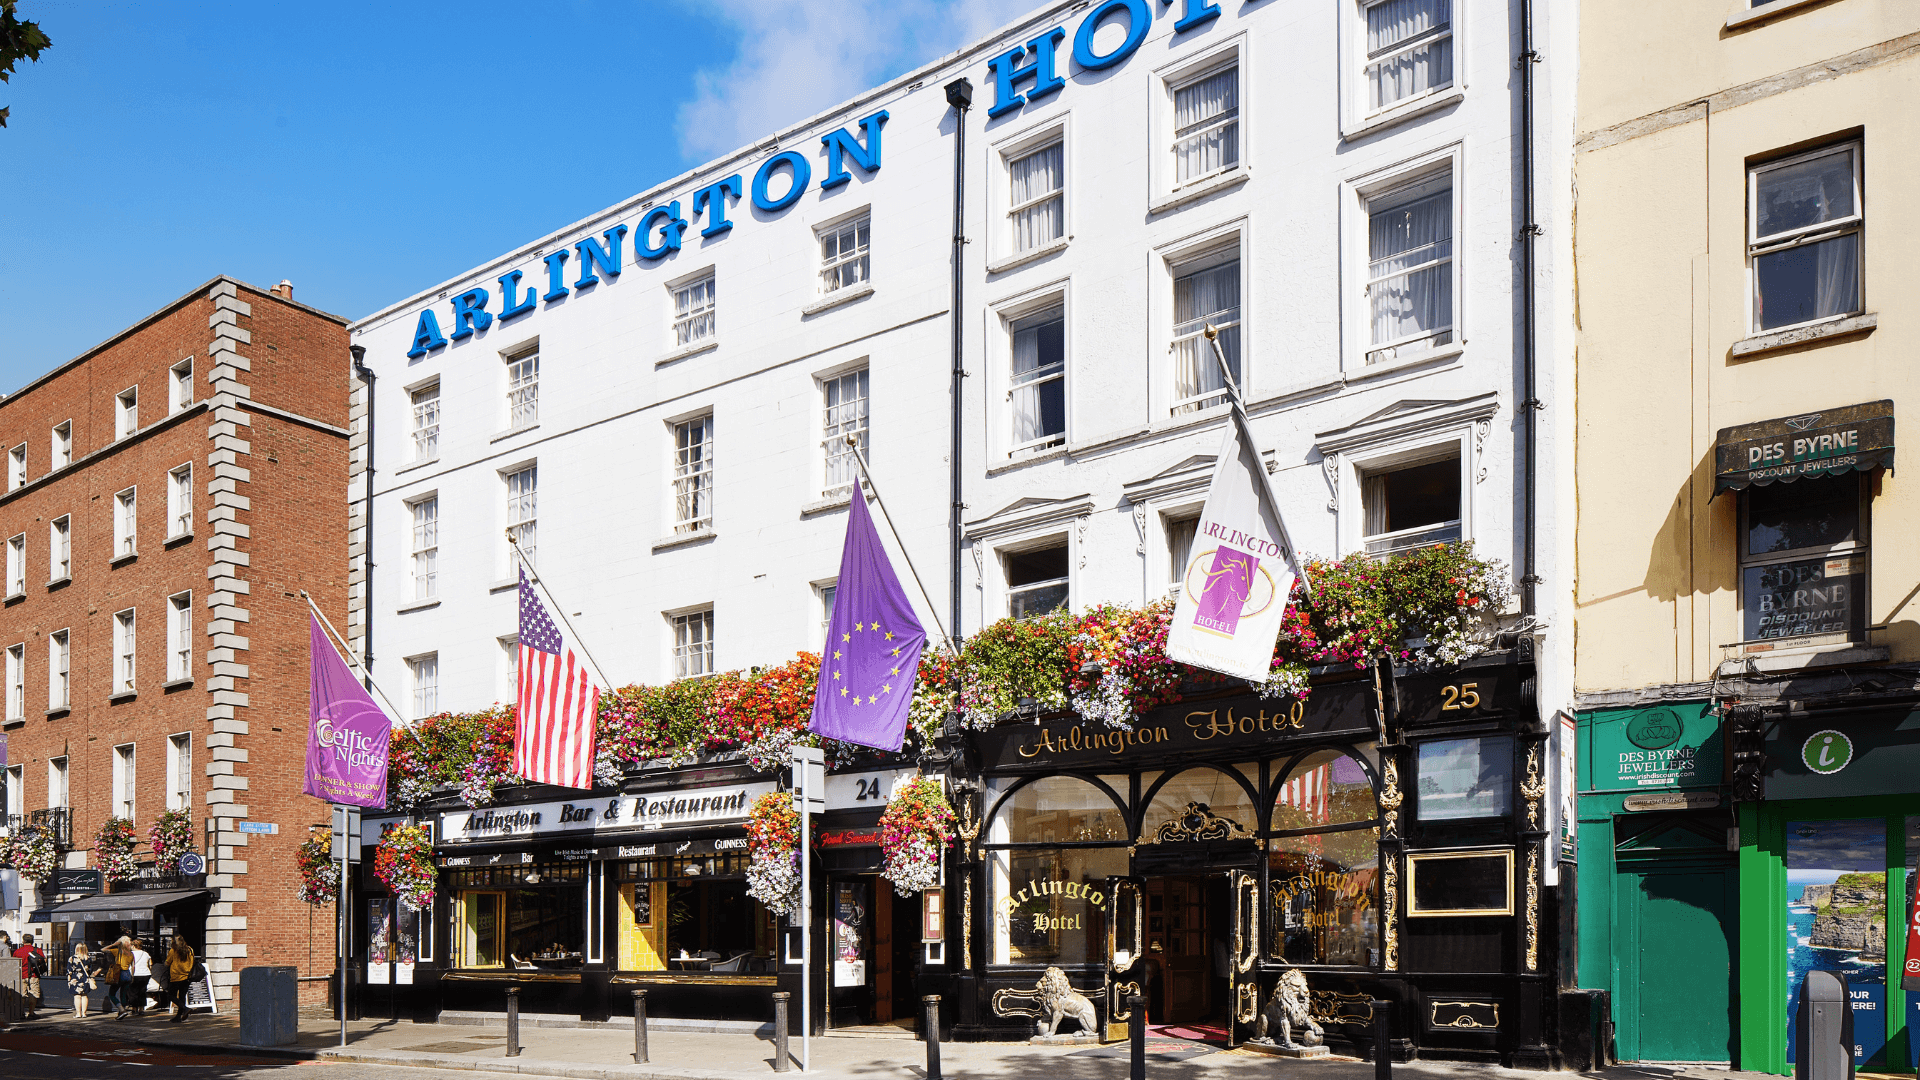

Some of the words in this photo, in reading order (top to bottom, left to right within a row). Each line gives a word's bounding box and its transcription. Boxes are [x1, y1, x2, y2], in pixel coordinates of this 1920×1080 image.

[407, 109, 890, 359] ARLINGTON
[1749, 442, 1784, 464] DES
[1793, 430, 1858, 456] BYRNE
[1749, 465, 1797, 480] DISCOUNT
[1800, 455, 1857, 473] JEWELLERS
[1777, 564, 1822, 586] DES
[1759, 584, 1845, 612] BYRNE
[1197, 615, 1232, 633] HOTEL
[1759, 608, 1847, 626] DISCOUNT
[1758, 621, 1845, 639] JEWELLER
[1440, 682, 1480, 711] 25
[316, 719, 372, 751] Celtic
[1018, 725, 1169, 758] Arlington
[1184, 700, 1305, 741] Hotel
[1618, 759, 1695, 774] JEWELLERS
[1619, 752, 1644, 763] DES
[1648, 748, 1694, 761] BYRNE
[353, 782, 380, 791] SHOW
[1618, 771, 1695, 780] www.irishdiscount.com
[855, 777, 880, 800] 24
[462, 809, 543, 834] Arlington
[558, 803, 594, 823] Bar
[603, 799, 620, 820] &
[633, 789, 747, 817] Restaurant
[447, 857, 471, 866] GUINNESS
[521, 852, 534, 863] Bar
[618, 844, 656, 857] Restaurant
[715, 838, 747, 849] GUINNESS
[998, 876, 1107, 916] Arlingto
[1275, 870, 1371, 915] Arlington
[1032, 913, 1082, 934] Hotel
[1301, 908, 1341, 932] Hotel
[1850, 1001, 1876, 1010] ERE!
